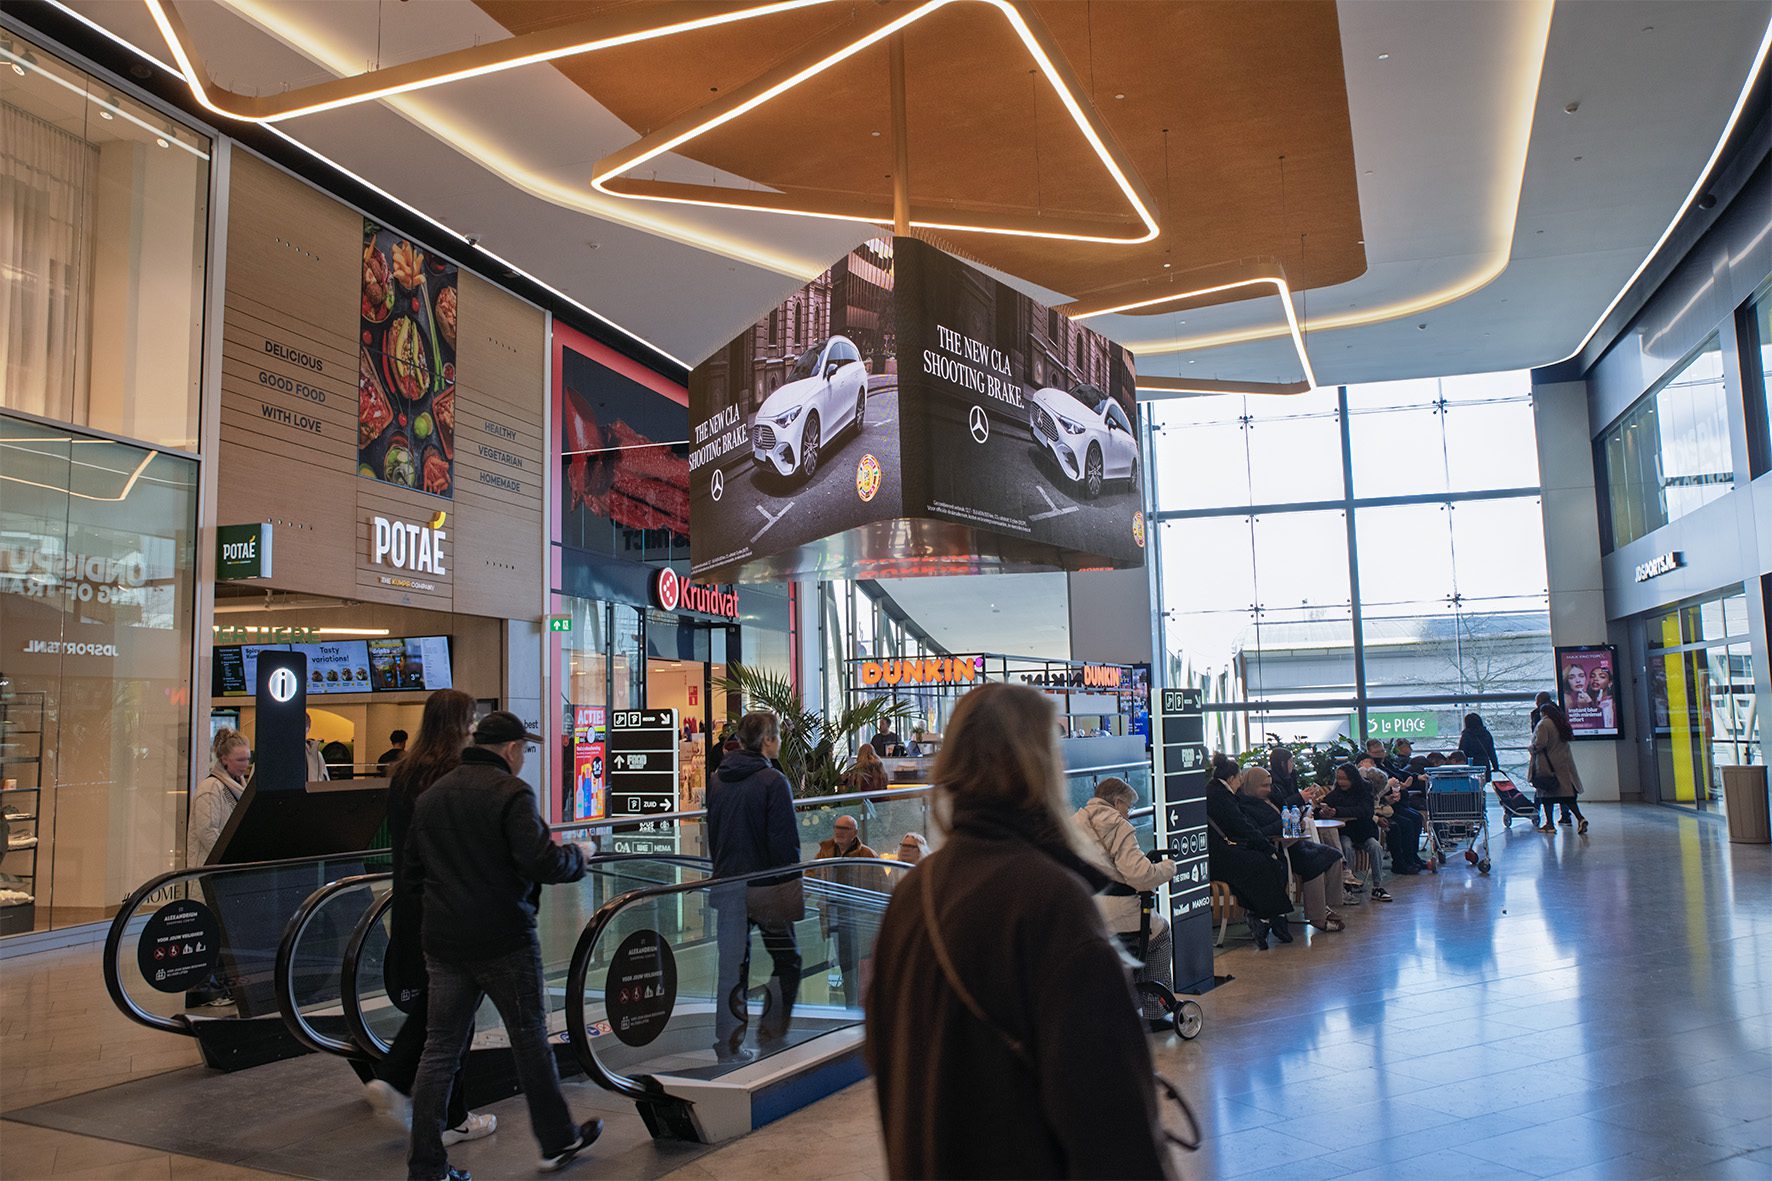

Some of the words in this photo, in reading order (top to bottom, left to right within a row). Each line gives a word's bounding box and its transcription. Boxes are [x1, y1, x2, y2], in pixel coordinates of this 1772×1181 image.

[265, 340, 323, 371] DELICIOUS
[937, 324, 962, 356] THE
[964, 336, 989, 367] NEW
[991, 349, 1012, 377] CLA
[259, 372, 293, 391] GOOD
[296, 384, 326, 402] FOOD
[923, 349, 985, 393] SHOOTING
[987, 374, 1025, 409] BRAKE.
[261, 404, 291, 424] WITH
[294, 414, 322, 433] LOVE
[484, 421, 517, 440] HEALTHY
[694, 420, 709, 445] THE
[709, 410, 725, 437] NEW
[725, 402, 740, 426] CLA
[478, 444, 523, 467] VEGETARIAN
[688, 437, 722, 472] SHOOTING
[479, 471, 521, 492] HOMEMADE
[223, 535, 256, 560] POTAÉ
[374, 511, 446, 575] POTAÉ
[680, 576, 740, 619] Kruidvat
[311, 655, 349, 663] variations!
[319, 646, 340, 655] Tasty
[523, 719, 539, 729] best
[577, 709, 604, 725] ACTIE!
[1394, 718, 1425, 732] PLACE
[1192, 896, 1210, 909] MANGO
